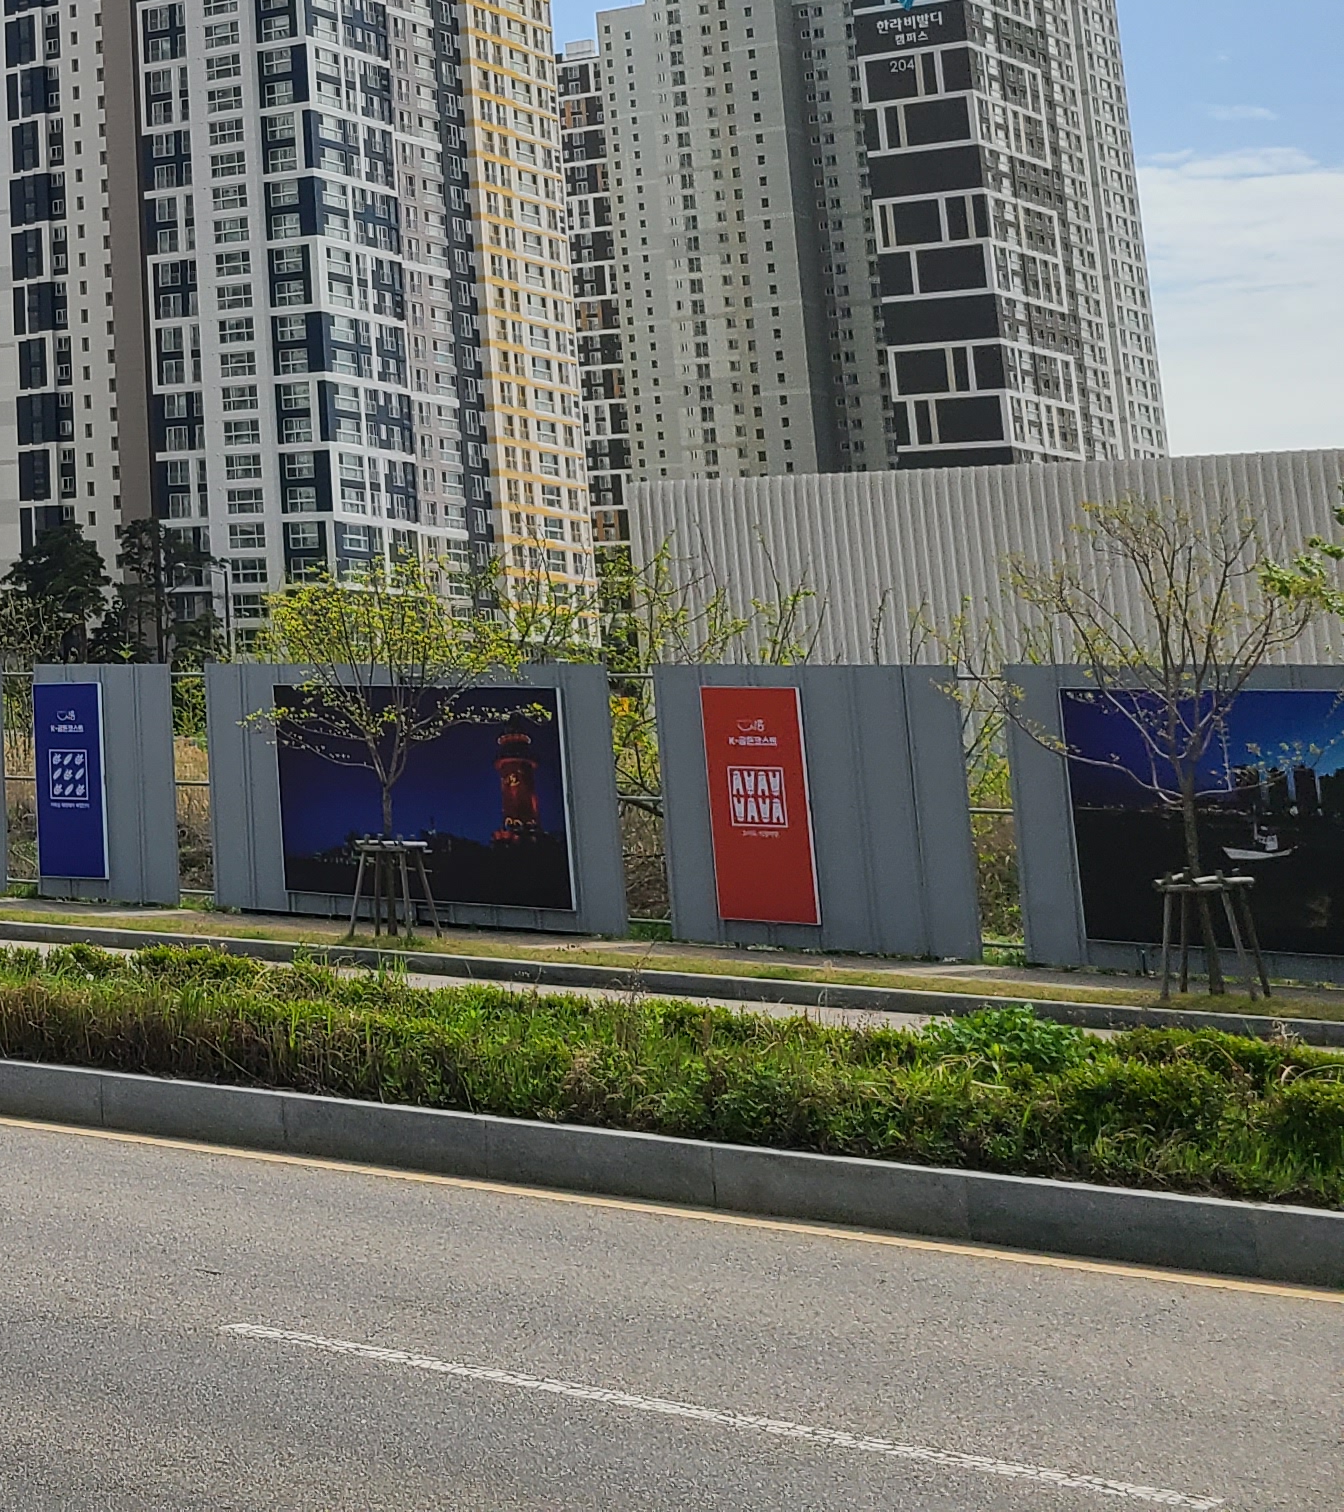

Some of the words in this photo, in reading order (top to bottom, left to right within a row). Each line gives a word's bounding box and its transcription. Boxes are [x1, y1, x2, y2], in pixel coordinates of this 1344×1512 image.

[876, 11, 943, 35] 한라비발디
[894, 30, 929, 46] 캠퍼스
[889, 59, 915, 73] 204
